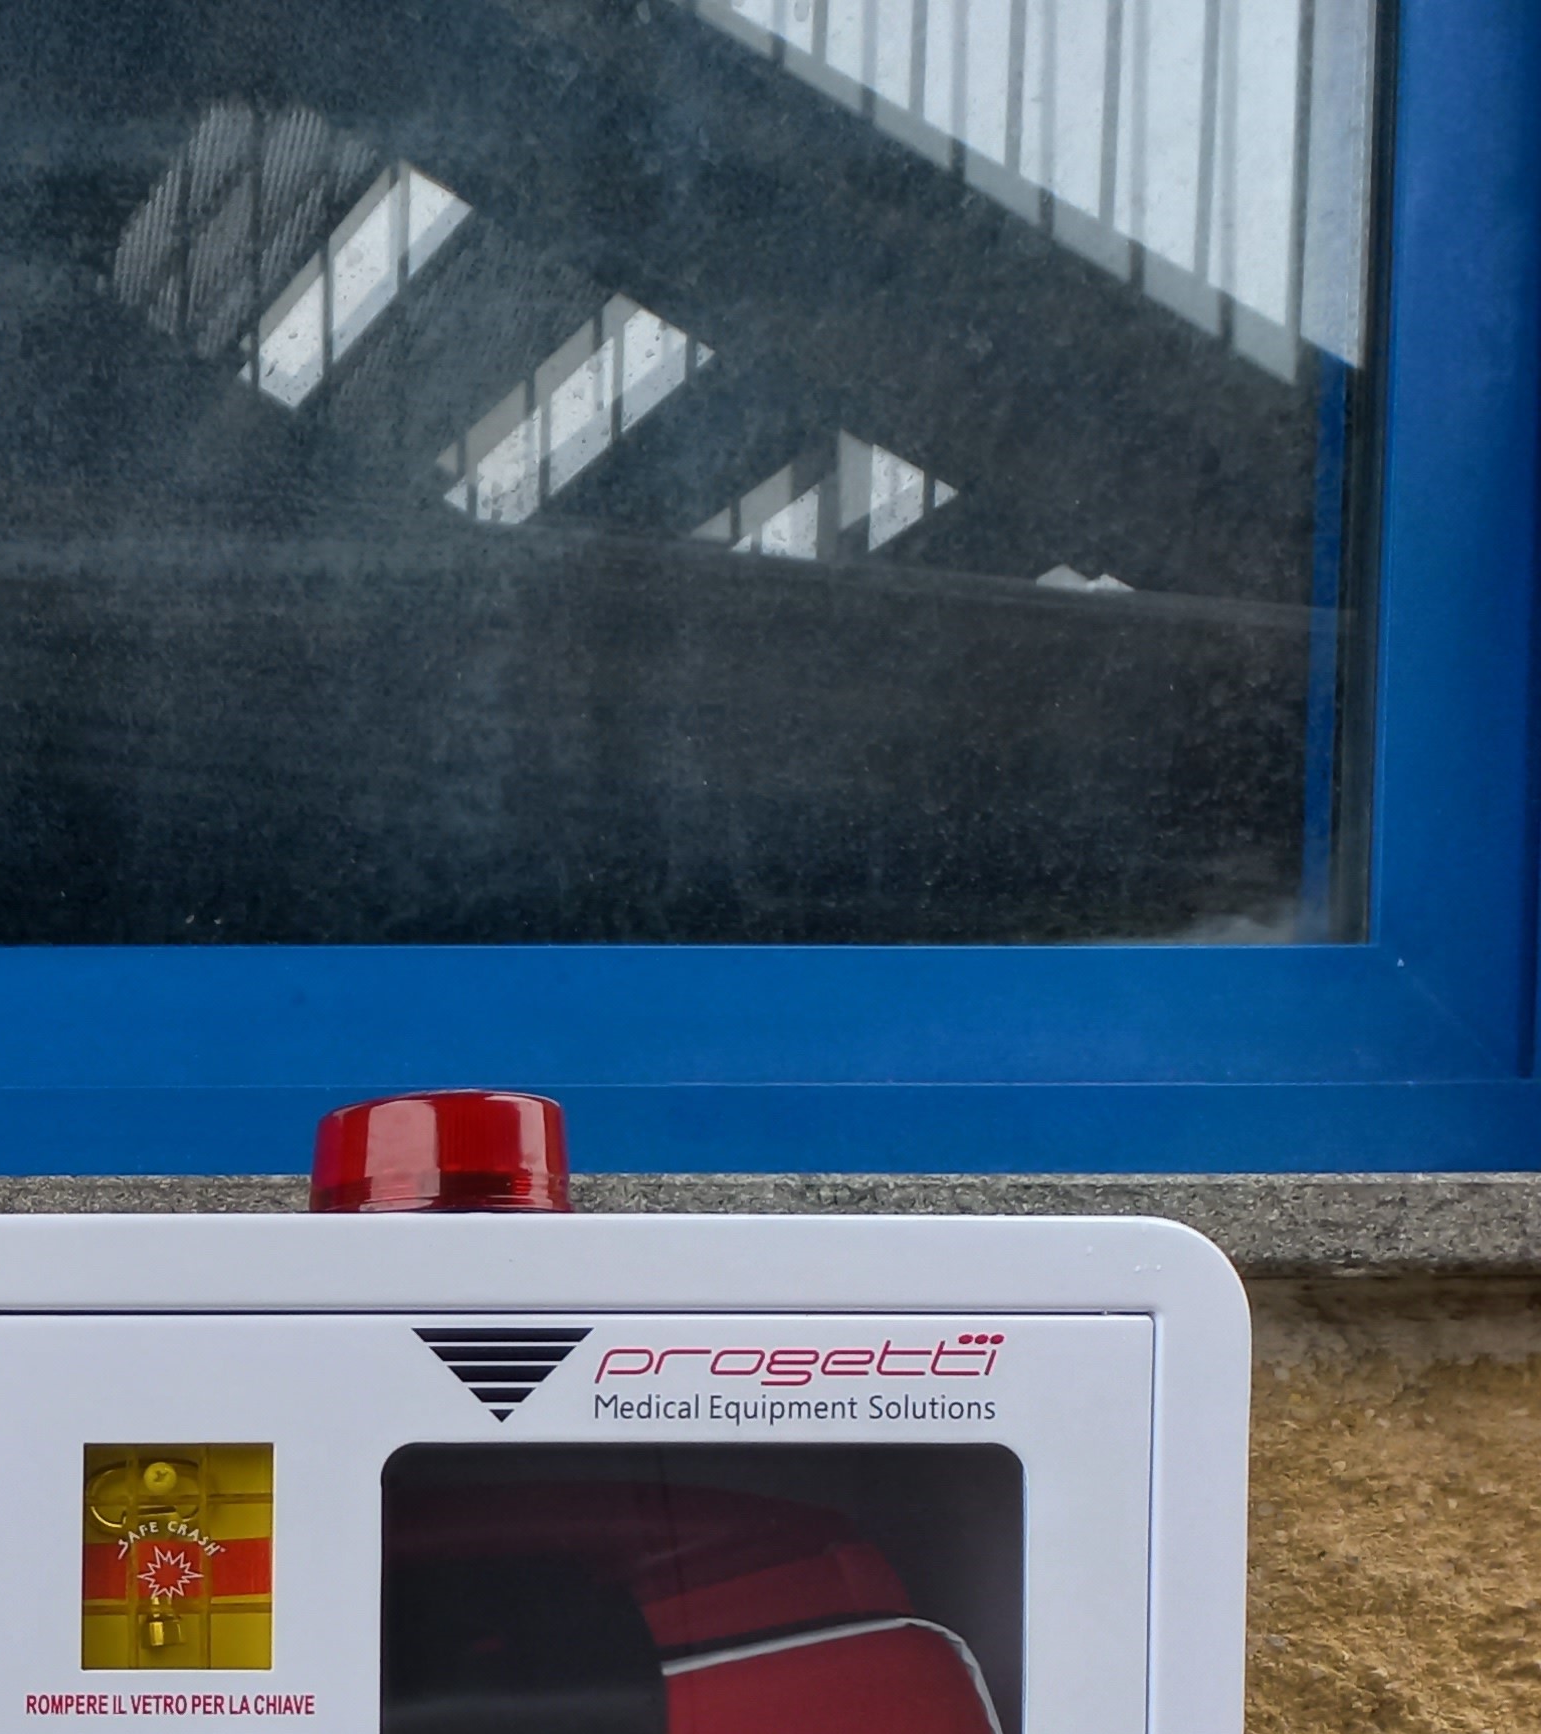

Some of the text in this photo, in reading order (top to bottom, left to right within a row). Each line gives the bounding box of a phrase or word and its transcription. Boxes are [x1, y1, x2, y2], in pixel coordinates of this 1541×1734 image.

[594, 1334, 1004, 1387] progetti
[595, 1394, 995, 1426] Medical Equipment Solutions
[27, 1695, 314, 1715] ROMPERE IL VETRO PER LA CHIAVE
